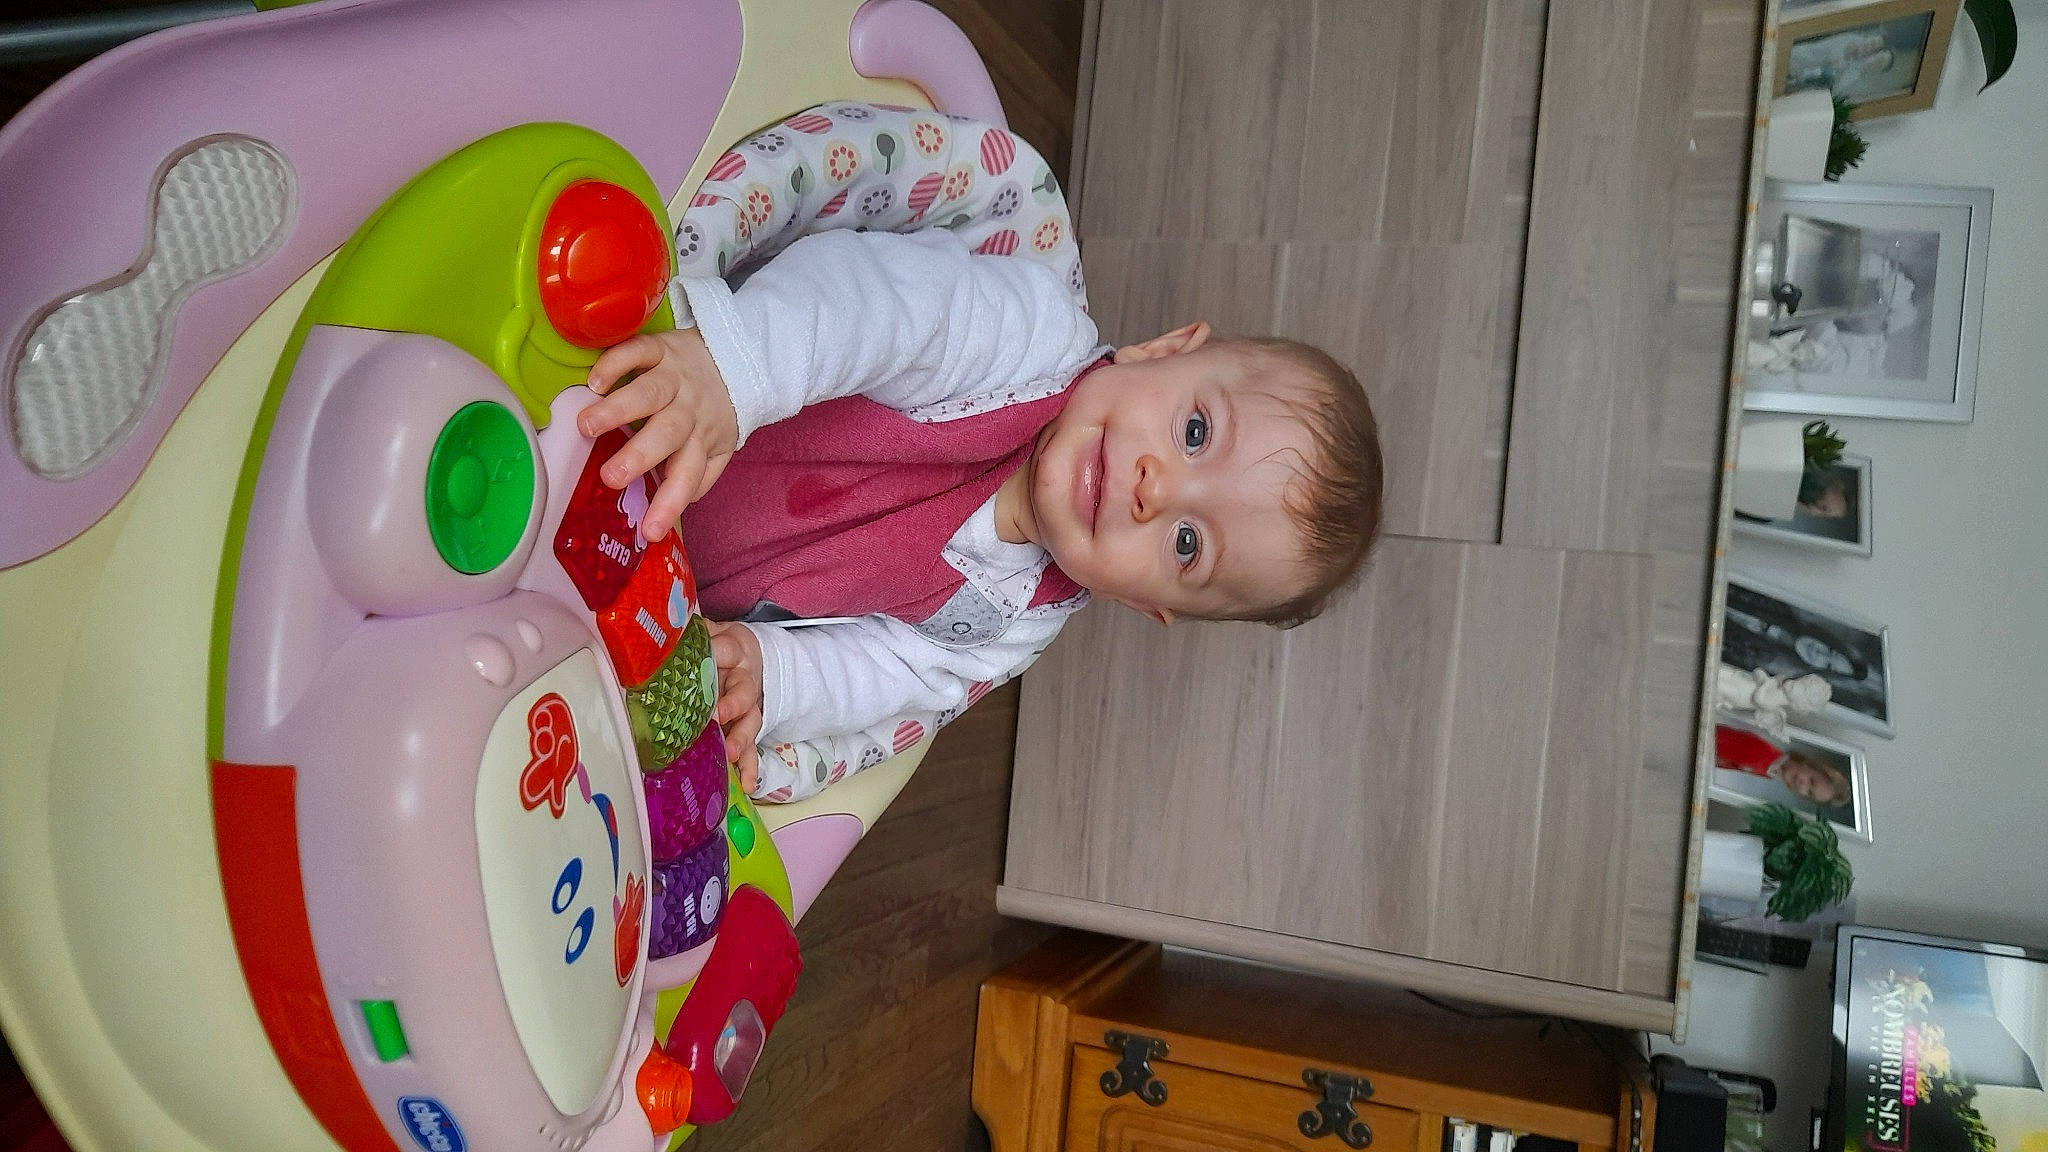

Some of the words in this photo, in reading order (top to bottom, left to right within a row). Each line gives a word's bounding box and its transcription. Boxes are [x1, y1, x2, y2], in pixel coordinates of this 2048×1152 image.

[598, 533, 631, 567] CLAPS
[684, 891, 695, 917] HA
[686, 913, 697, 938] HA
[1878, 985, 1905, 1142] NOMBREUSES
[1904, 1029, 1916, 1101] FAMILLES
